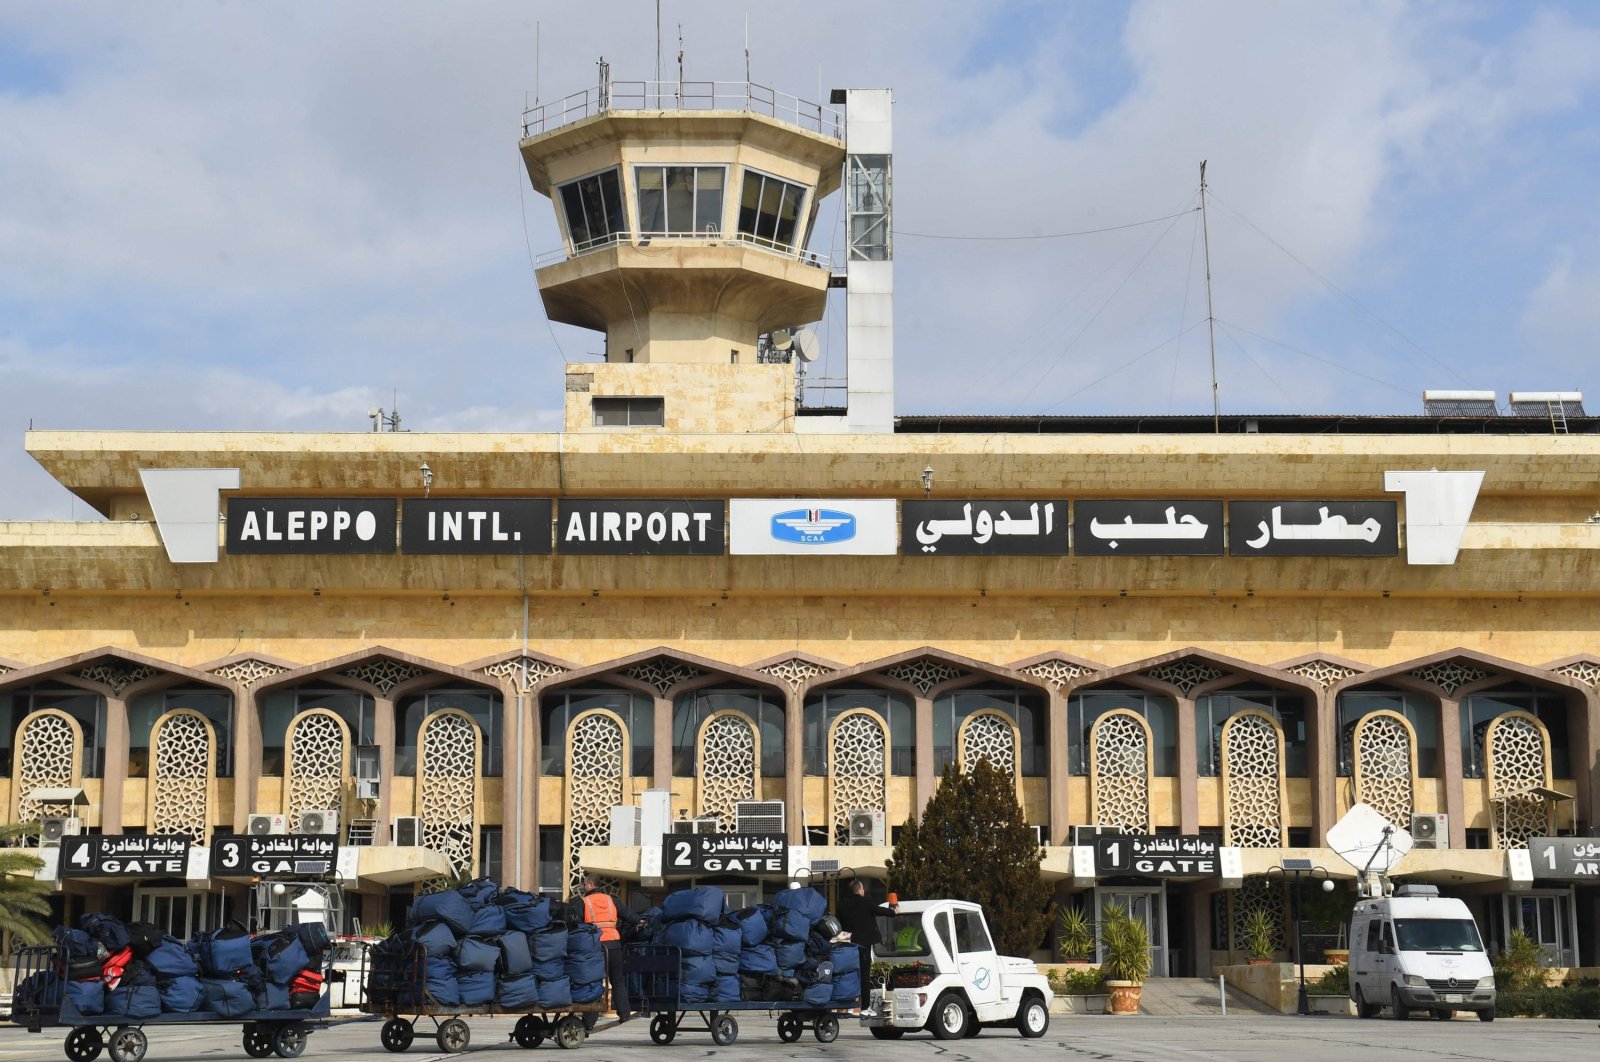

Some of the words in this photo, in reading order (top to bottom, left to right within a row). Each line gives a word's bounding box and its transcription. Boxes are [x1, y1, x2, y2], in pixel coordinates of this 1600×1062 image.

[240, 510, 377, 542] ALEPPO
[428, 511, 521, 541] INTL.
[565, 511, 712, 542] AIRPORT
[915, 503, 1055, 553] الدولي
[1089, 505, 1209, 550] حلب
[1245, 506, 1382, 549] مطار
[101, 838, 149, 855] المغادرة
[152, 838, 185, 854] بوابة
[250, 838, 298, 855] المغادرة
[301, 838, 334, 855] بوابة
[701, 836, 748, 853] المغادرة
[751, 836, 784, 853] بوابة
[1133, 838, 1179, 855] المغادرة
[1182, 838, 1215, 855] بوابة
[71, 843, 90, 868] 4
[222, 842, 240, 868] 3
[674, 841, 692, 866] 2
[1106, 842, 1120, 867] 1
[1543, 845, 1557, 870] 1
[101, 860, 183, 873] GATE
[251, 860, 332, 873] GA
[703, 859, 783, 871] GATE
[1135, 860, 1215, 873] GATE
[1574, 862, 1600, 875] AR
